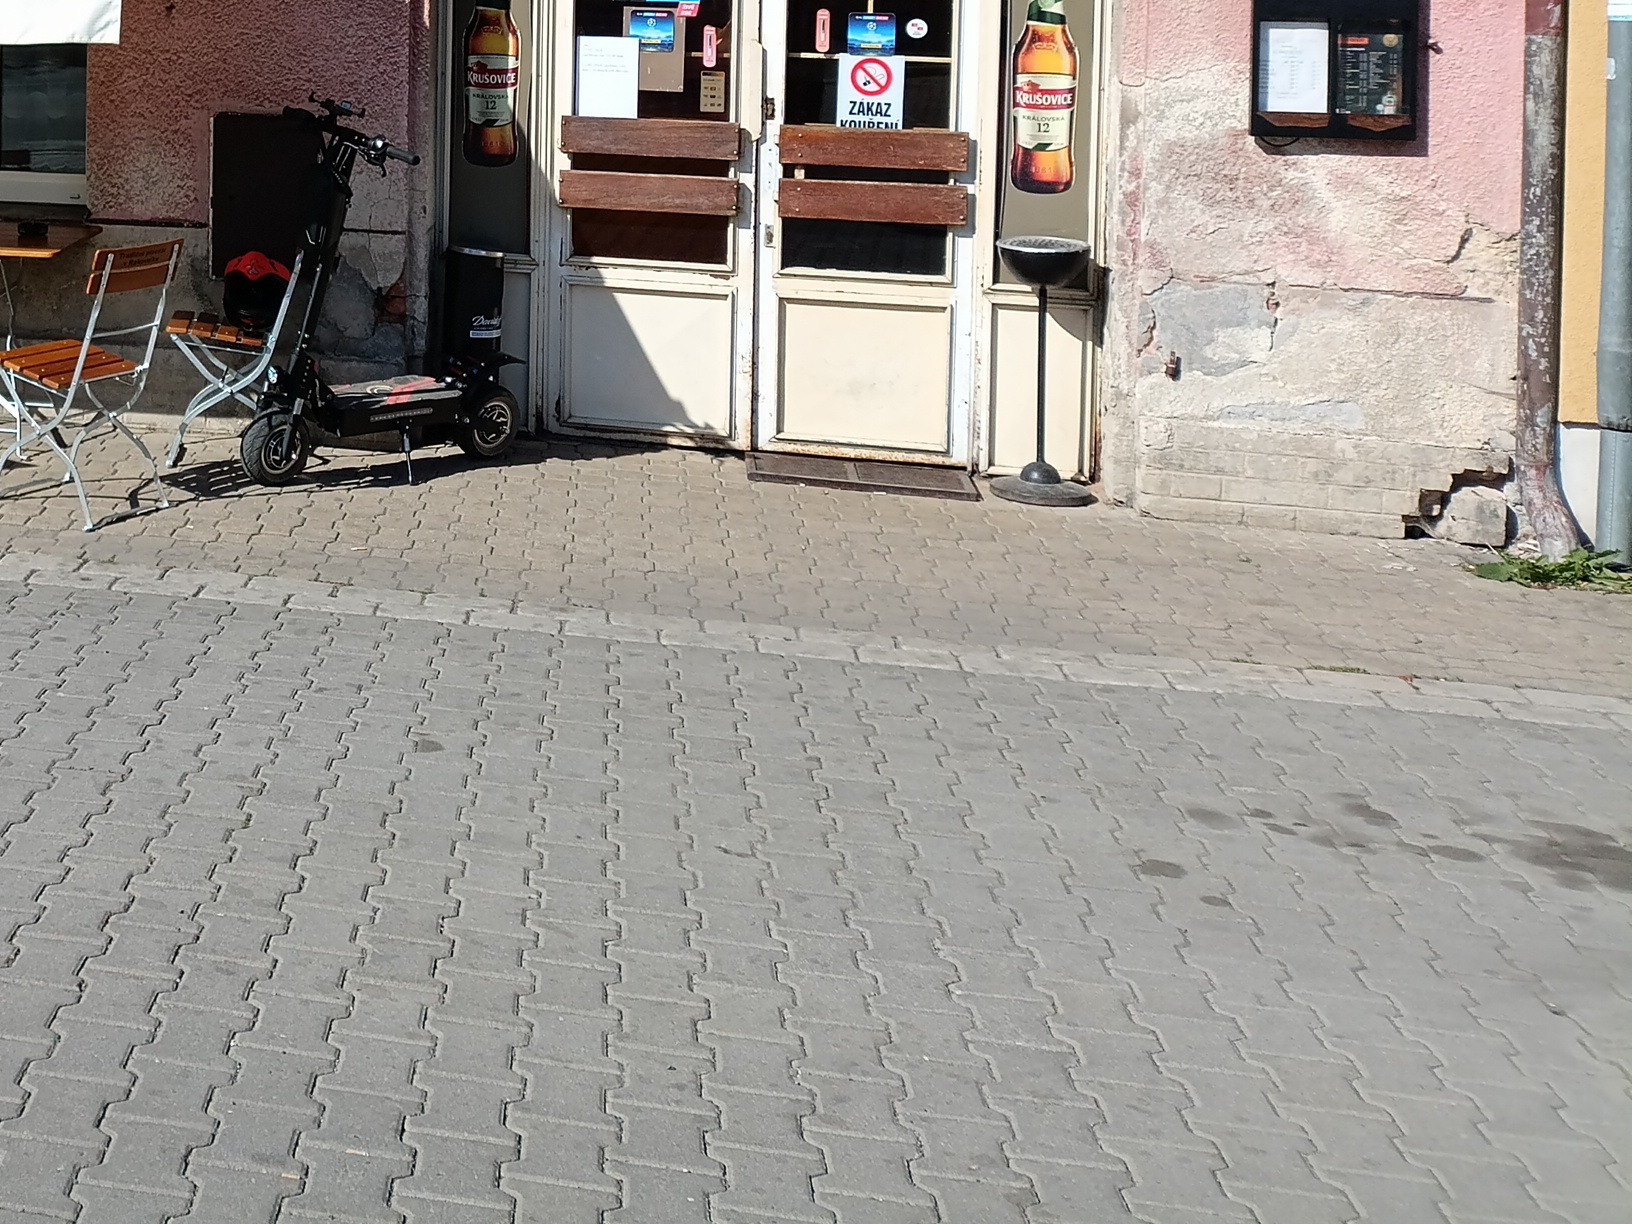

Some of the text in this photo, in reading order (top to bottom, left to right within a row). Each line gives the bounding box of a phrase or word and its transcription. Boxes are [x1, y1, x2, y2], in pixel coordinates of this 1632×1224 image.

[468, 70, 516, 86] KRUŠOVICE
[485, 100, 497, 110] 12
[1016, 90, 1073, 107] KRUŠOVICE
[849, 98, 892, 118] ZÁKAZ
[1037, 122, 1051, 133] 12
